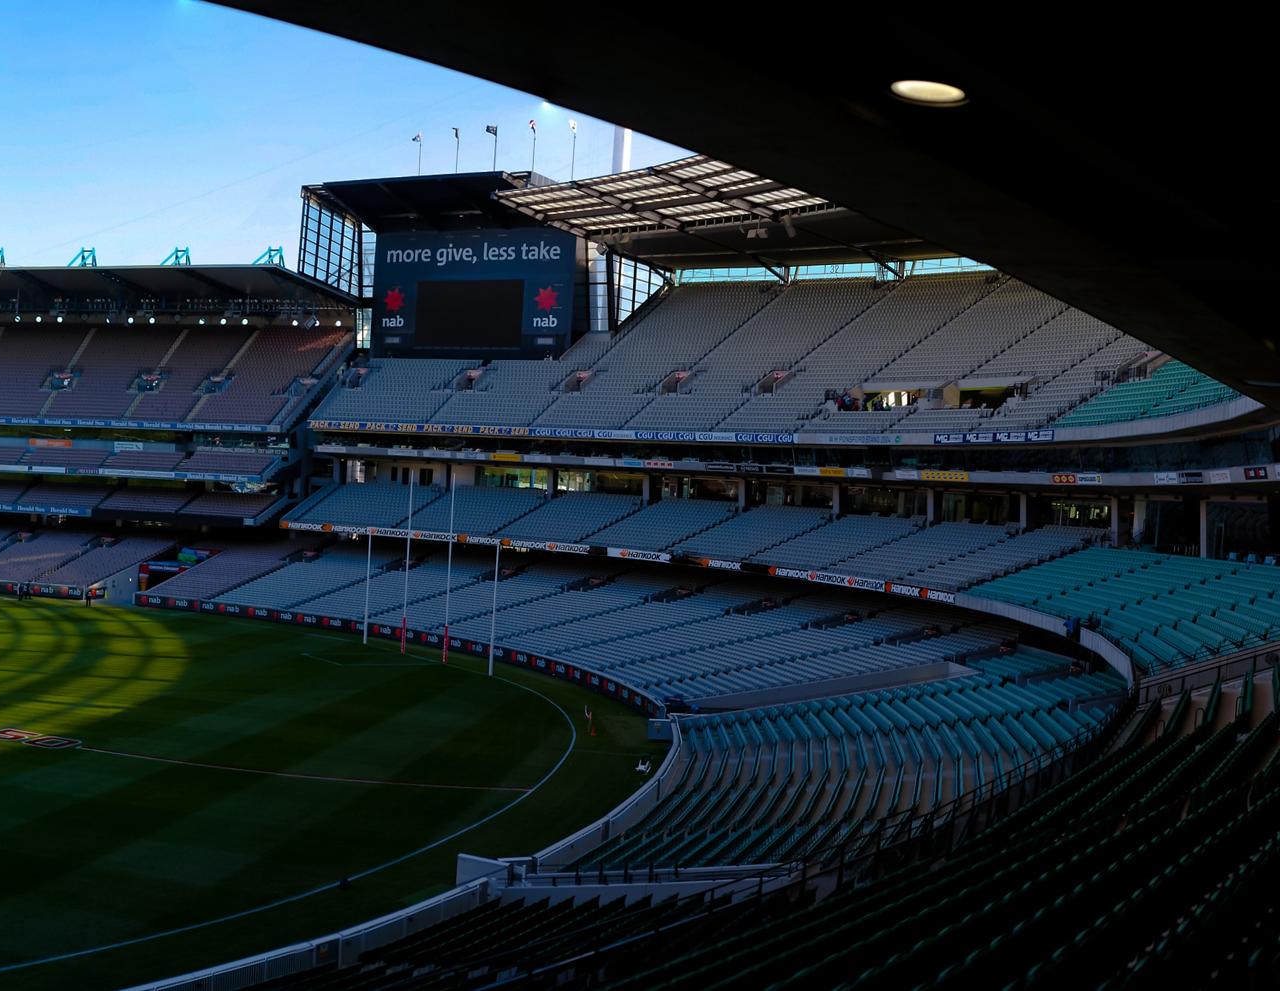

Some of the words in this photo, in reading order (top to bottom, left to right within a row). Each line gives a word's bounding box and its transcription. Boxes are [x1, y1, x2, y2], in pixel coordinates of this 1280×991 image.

[387, 248, 431, 262] more
[437, 243, 477, 265] give,
[483, 242, 515, 260] less
[521, 241, 561, 260] take
[382, 315, 404, 327] nab
[534, 315, 557, 327] nab
[340, 421, 359, 429] SEND
[398, 423, 417, 431] SEND
[424, 424, 442, 432] PACK
[454, 425, 472, 433] SEND
[511, 427, 528, 435] SEND
[737, 433, 753, 441] CGU
[758, 434, 773, 442] CGU
[778, 434, 792, 442] CGU
[69, 587, 81, 595] nab
